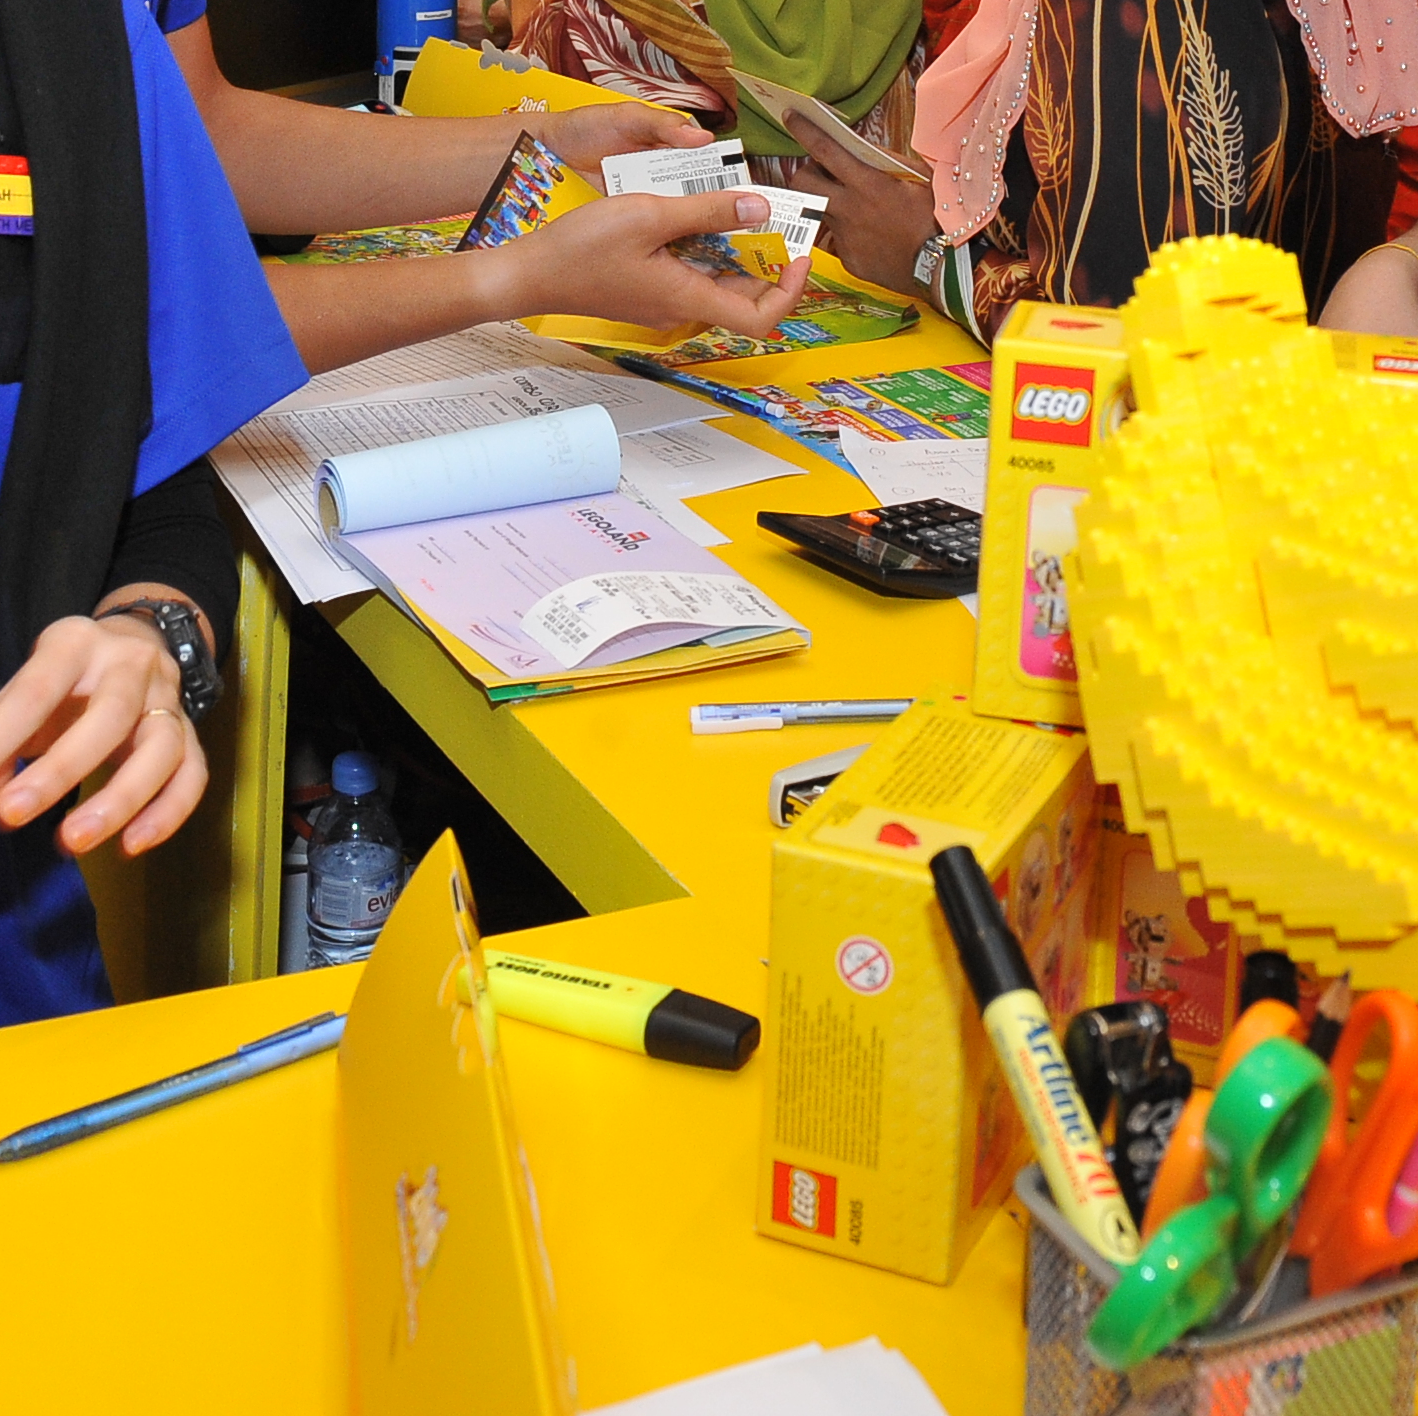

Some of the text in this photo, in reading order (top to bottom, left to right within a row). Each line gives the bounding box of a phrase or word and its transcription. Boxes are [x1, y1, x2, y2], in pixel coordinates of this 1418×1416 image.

[518, 96, 548, 113] 2016
[1017, 386, 1089, 424] LEGO
[577, 508, 647, 551] LEGOLAND
[495, 961, 540, 977] BOSS
[792, 1169, 818, 1230] LEGO
